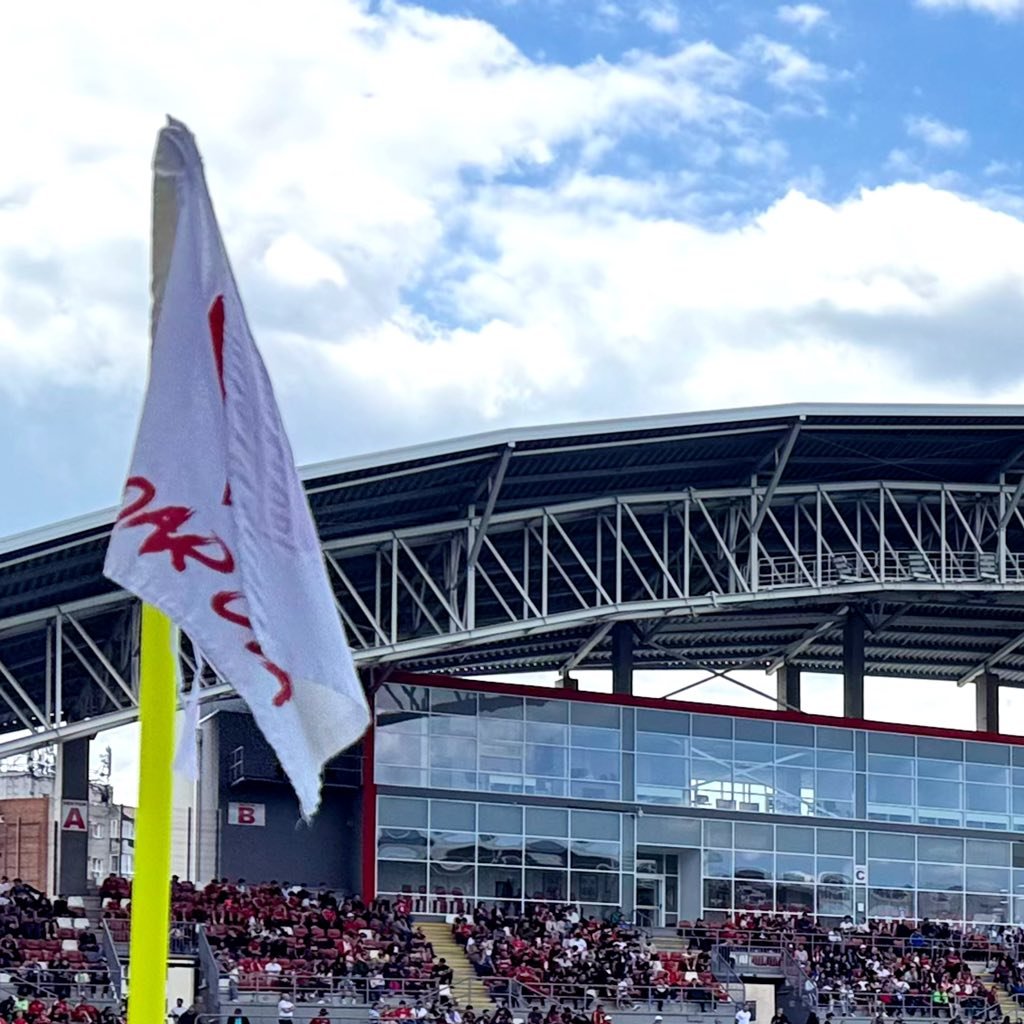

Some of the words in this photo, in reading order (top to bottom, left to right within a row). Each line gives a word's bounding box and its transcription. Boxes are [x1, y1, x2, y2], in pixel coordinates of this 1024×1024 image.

[63, 807, 86, 829] A
[238, 806, 256, 824] B
[856, 870, 865, 881] C
